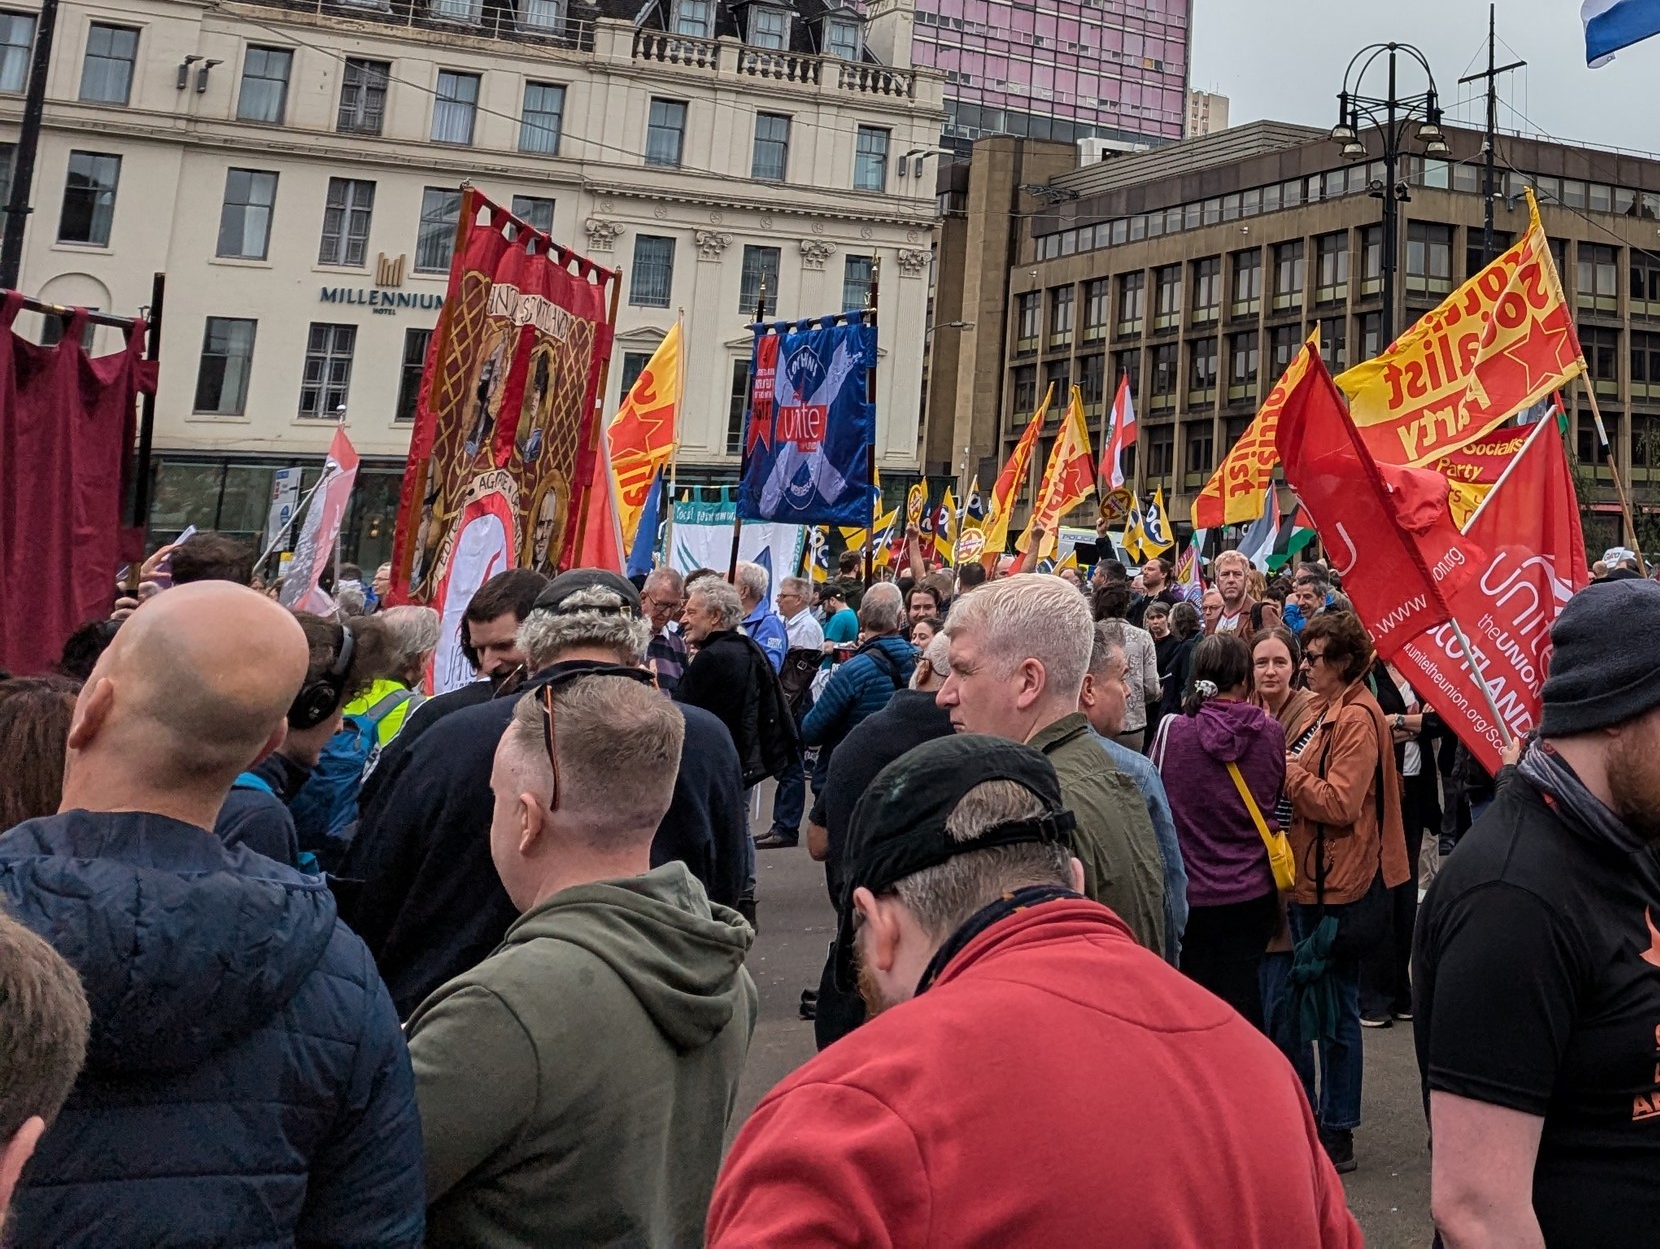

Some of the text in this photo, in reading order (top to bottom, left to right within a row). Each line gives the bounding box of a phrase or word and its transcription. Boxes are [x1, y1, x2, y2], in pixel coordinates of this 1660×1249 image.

[373, 307, 396, 316] HOTEL
[1462, 437, 1529, 456] Socialis
[1436, 457, 1484, 483] Party
